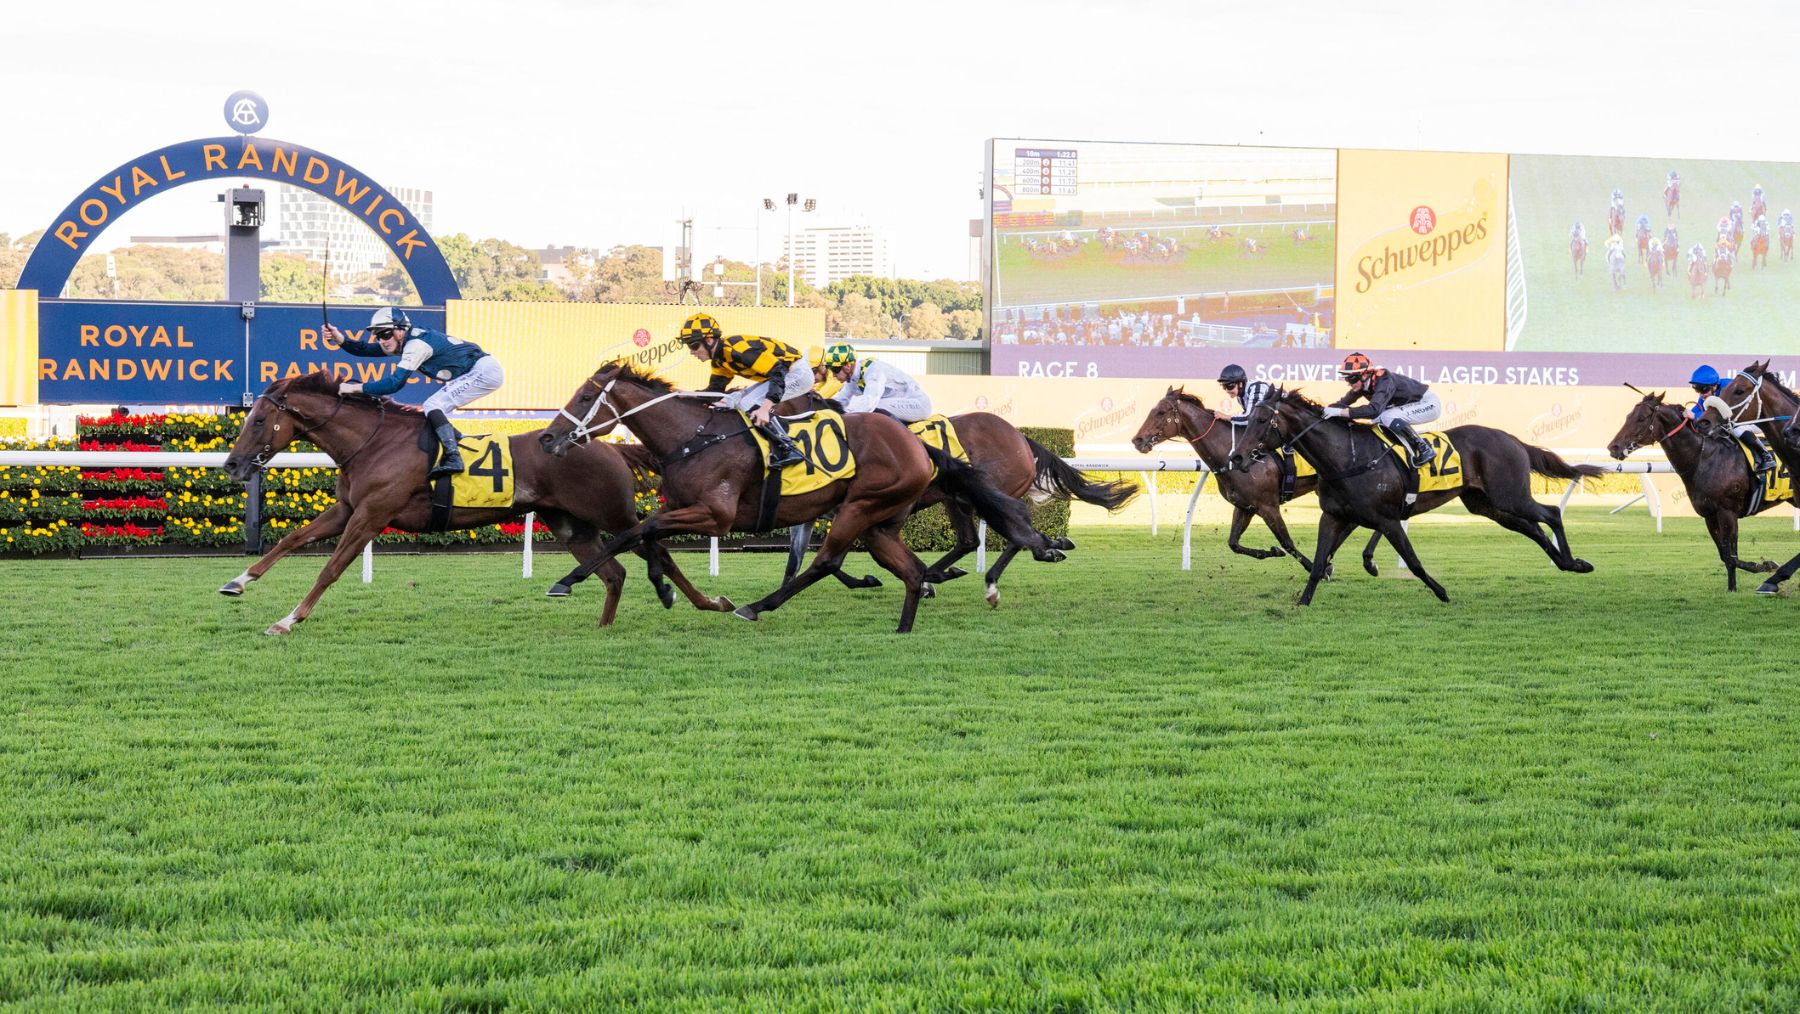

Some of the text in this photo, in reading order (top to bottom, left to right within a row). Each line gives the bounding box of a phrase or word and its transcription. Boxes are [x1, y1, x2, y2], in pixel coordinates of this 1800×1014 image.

[54, 144, 427, 260] ROYAL RANDWICK
[1355, 217, 1487, 293] Schweppes
[80, 325, 193, 347] ROYAL
[38, 358, 234, 381] RANDWICK
[1018, 361, 1099, 379] RACE 8
[1438, 366, 1498, 384] AGED
[1505, 367, 1580, 386] STAKES
[1077, 403, 1137, 440] Schweppes
[1531, 406, 1583, 441] Schweppes
[792, 418, 849, 475] 10
[1423, 437, 1459, 477] 12
[469, 440, 509, 493] 4
[1158, 460, 1167, 471] 2
[1616, 463, 1623, 473] 4
